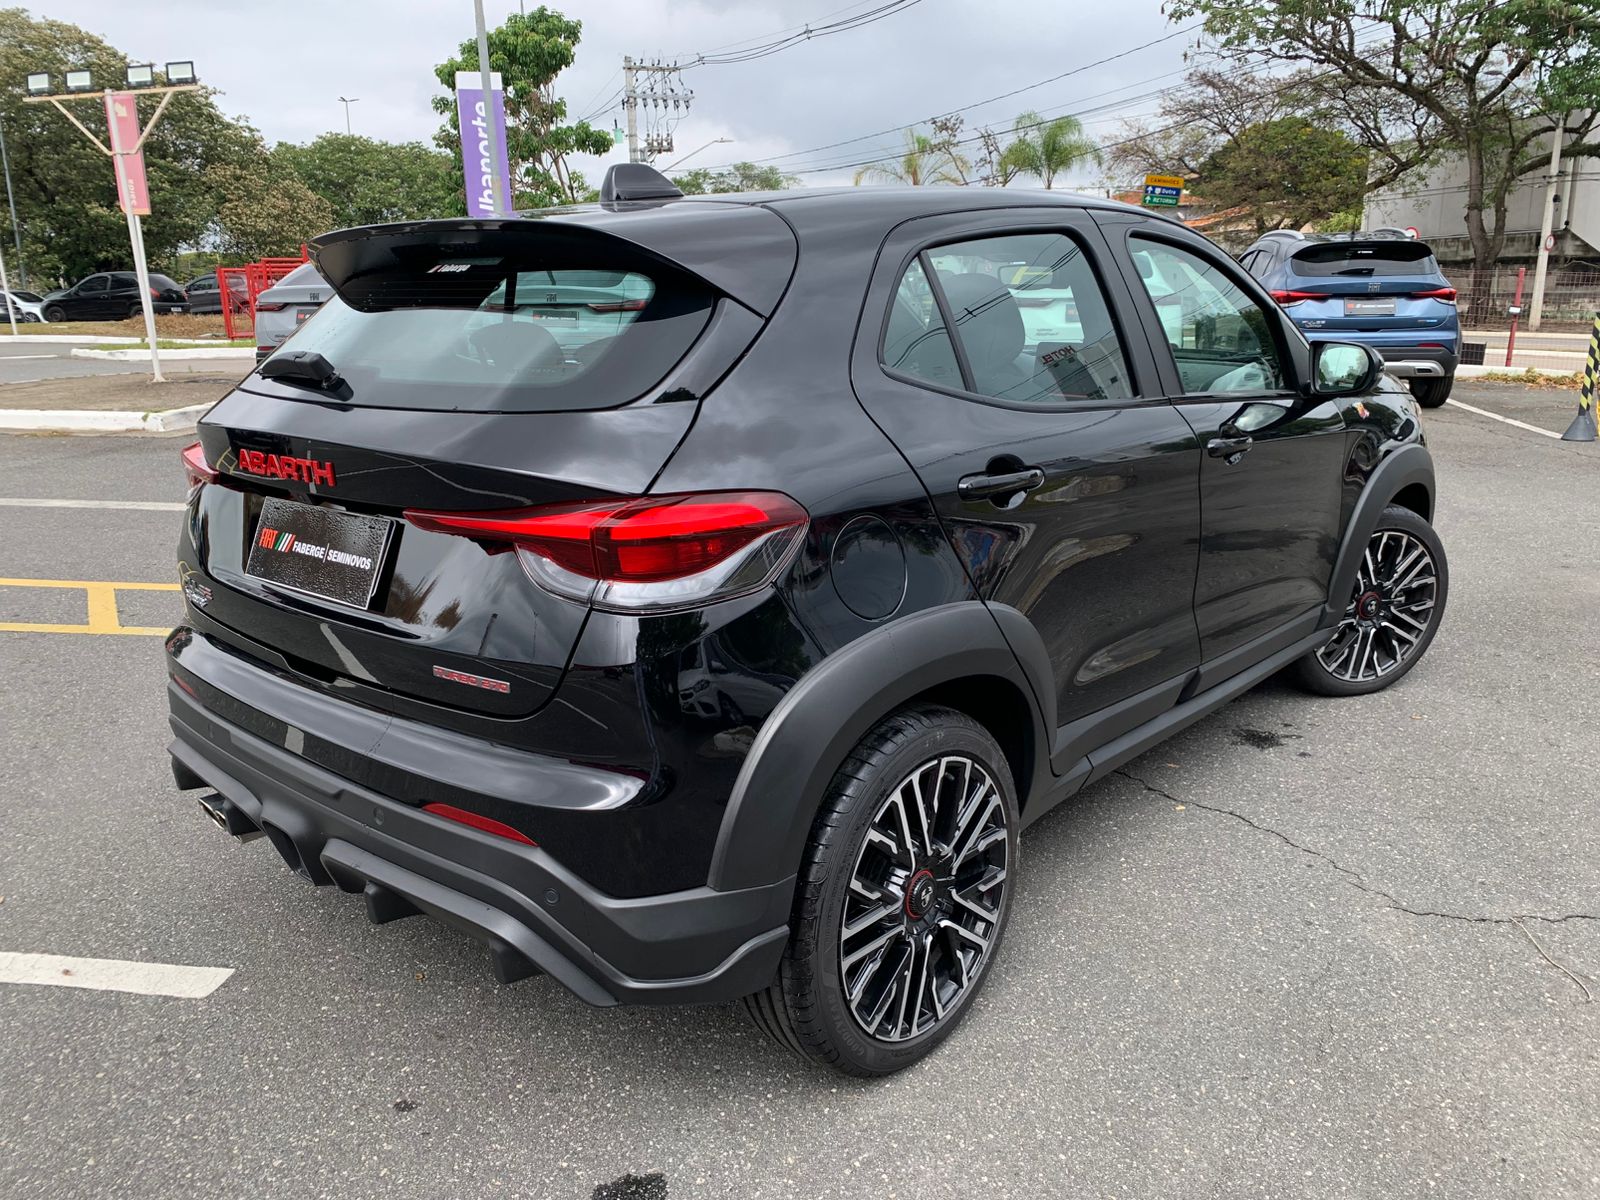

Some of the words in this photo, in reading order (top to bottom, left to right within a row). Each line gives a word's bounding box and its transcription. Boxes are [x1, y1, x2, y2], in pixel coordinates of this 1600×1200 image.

[239, 448, 335, 487] ABARTH
[258, 527, 279, 549] FIAT
[326, 549, 372, 570] SEMINOVOS
[433, 668, 478, 686] TURBO
[481, 678, 504, 694] 270
